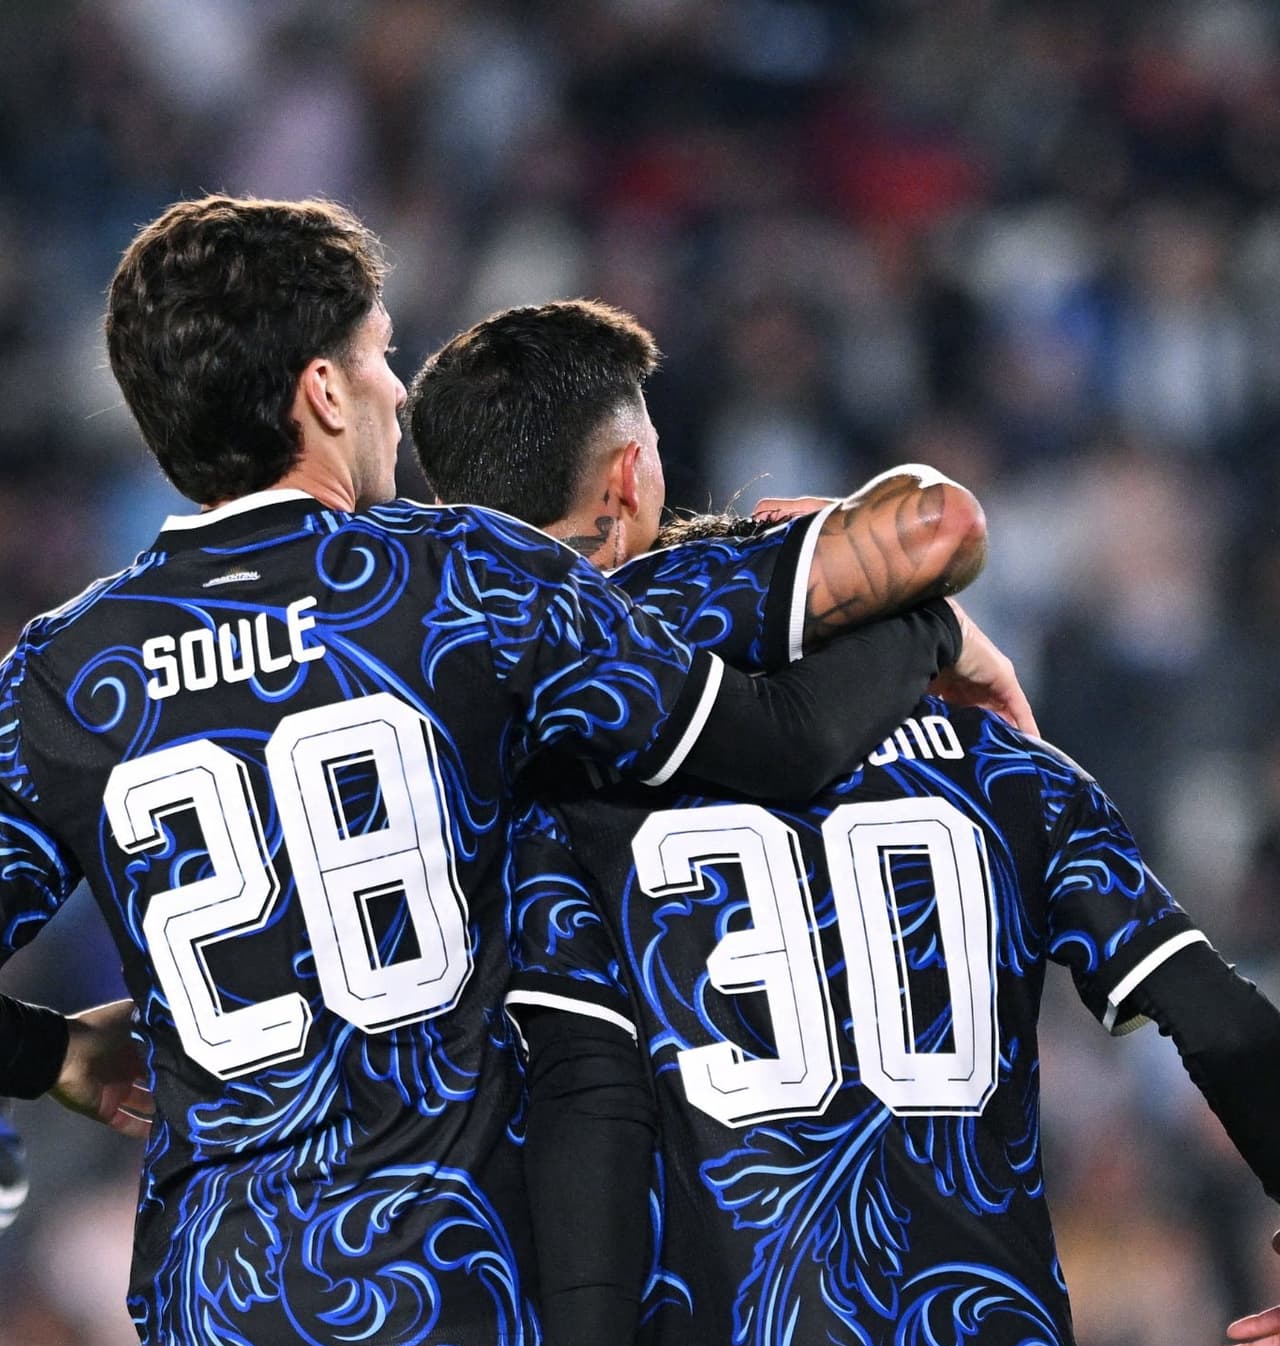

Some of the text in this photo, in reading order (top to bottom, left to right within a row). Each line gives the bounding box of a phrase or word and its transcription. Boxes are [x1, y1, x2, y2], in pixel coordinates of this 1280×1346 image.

[142, 595, 326, 701] SOULE
[103, 691, 475, 1081] 28
[631, 796, 1000, 1129] 30
